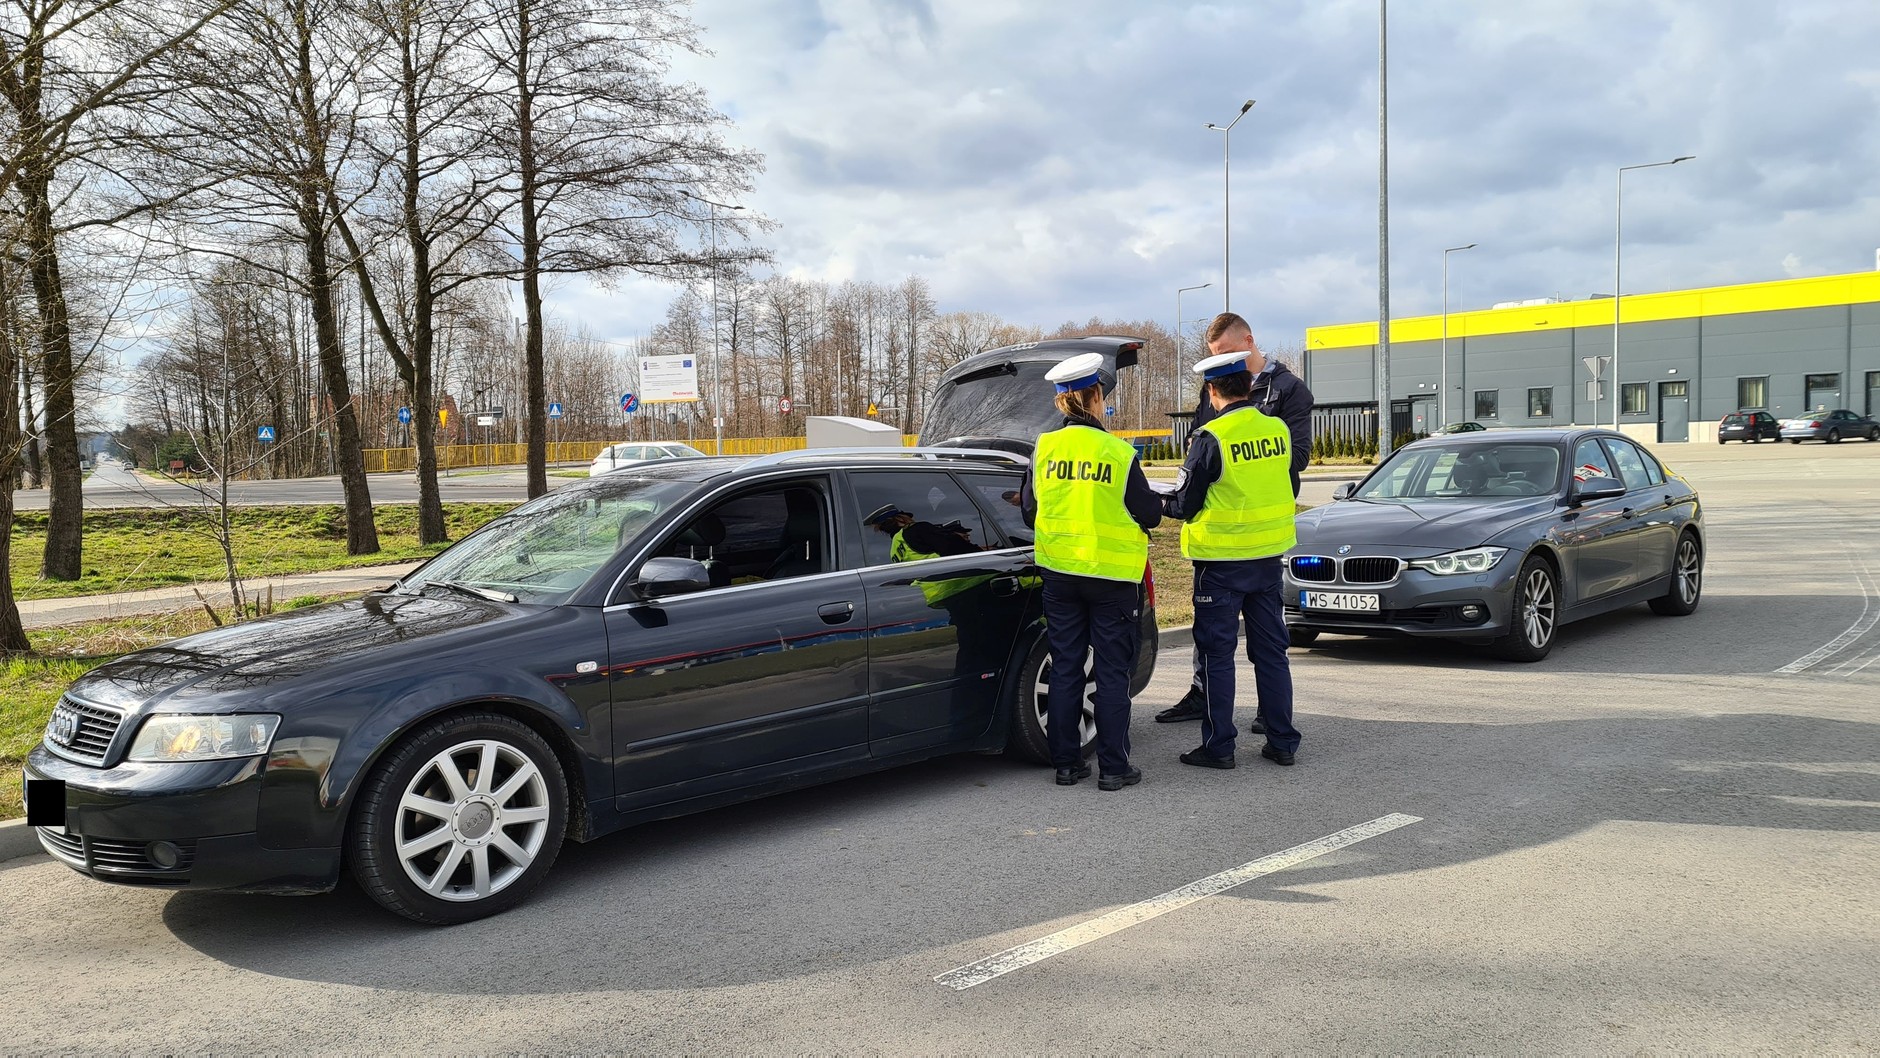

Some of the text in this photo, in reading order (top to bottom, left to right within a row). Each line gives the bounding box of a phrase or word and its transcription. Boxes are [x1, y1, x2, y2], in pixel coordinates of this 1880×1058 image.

[1230, 436, 1287, 463] POLICJA
[1046, 460, 1112, 483] POLICJA
[1194, 595, 1213, 603] POLICJA
[1309, 593, 1328, 608] WS
[1332, 594, 1378, 610] 41052
